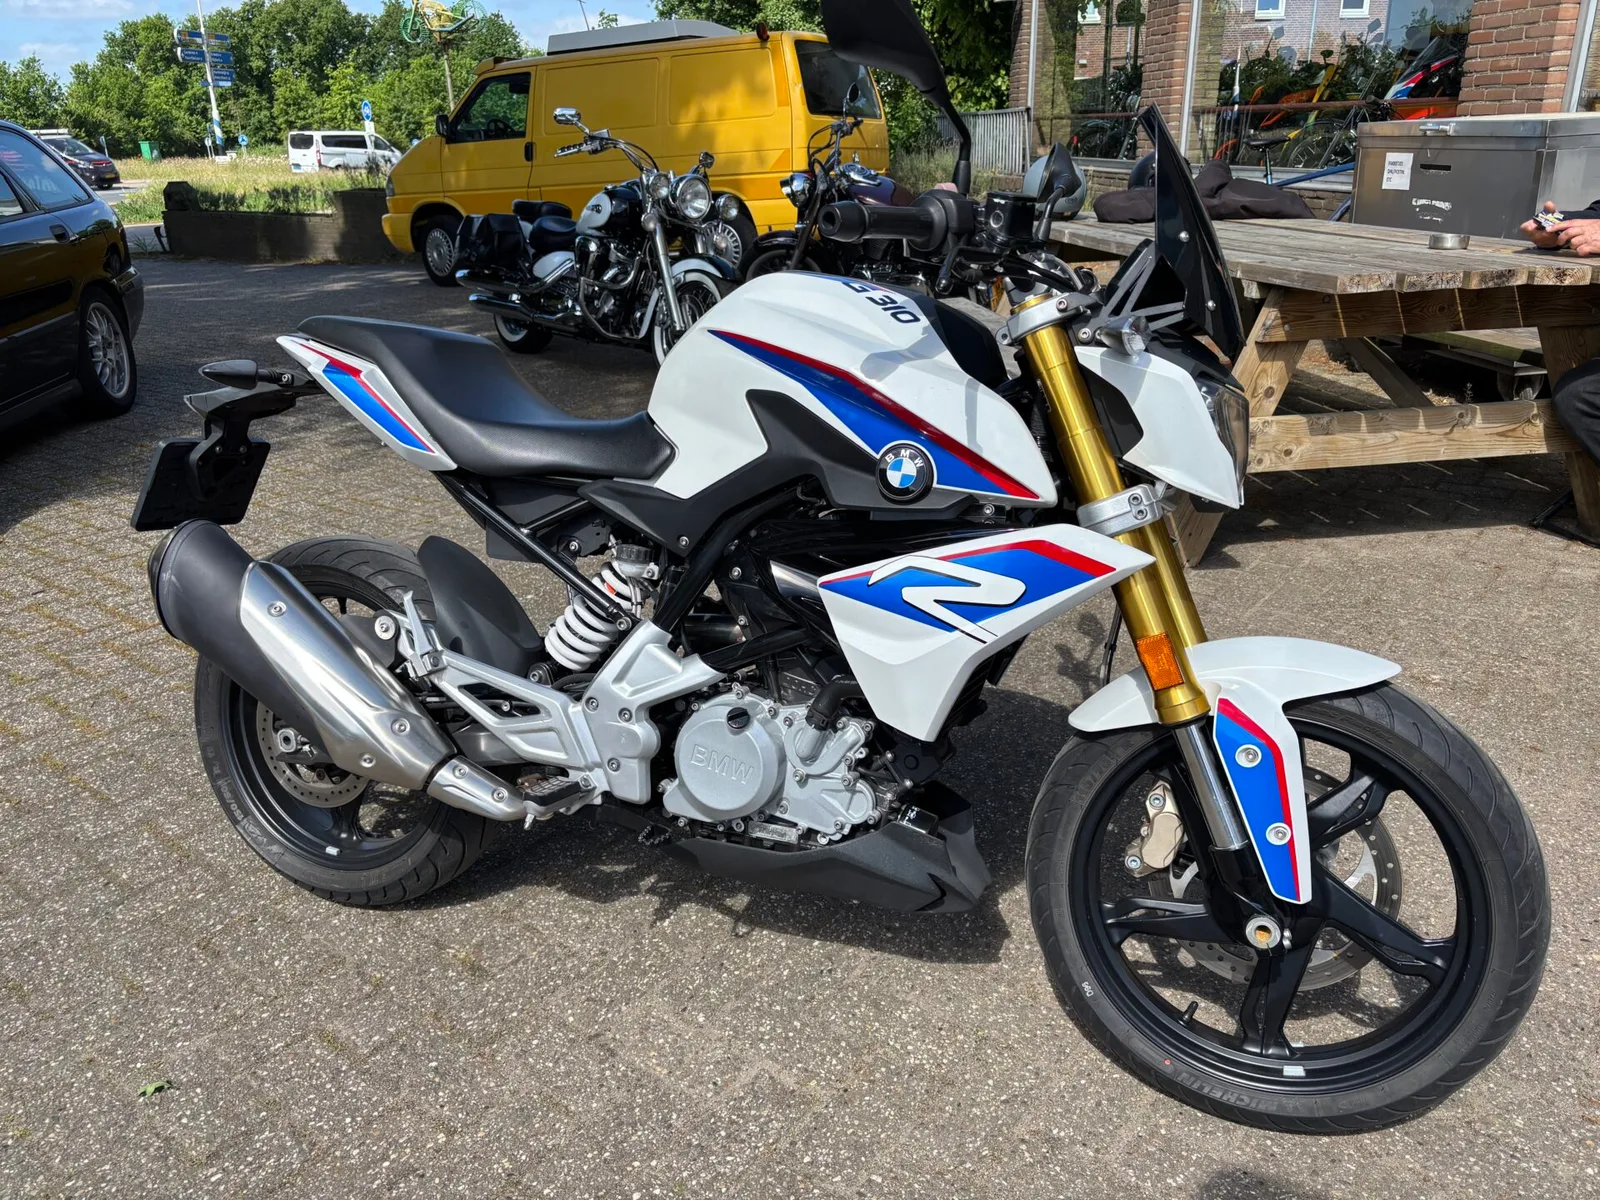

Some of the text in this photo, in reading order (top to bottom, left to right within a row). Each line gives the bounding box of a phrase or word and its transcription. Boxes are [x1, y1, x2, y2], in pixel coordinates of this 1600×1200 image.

[865, 295, 921, 324] 310
[885, 449, 924, 468] BMW
[690, 743, 755, 785] BMW
[1177, 1071, 1278, 1112] MICHELIN
